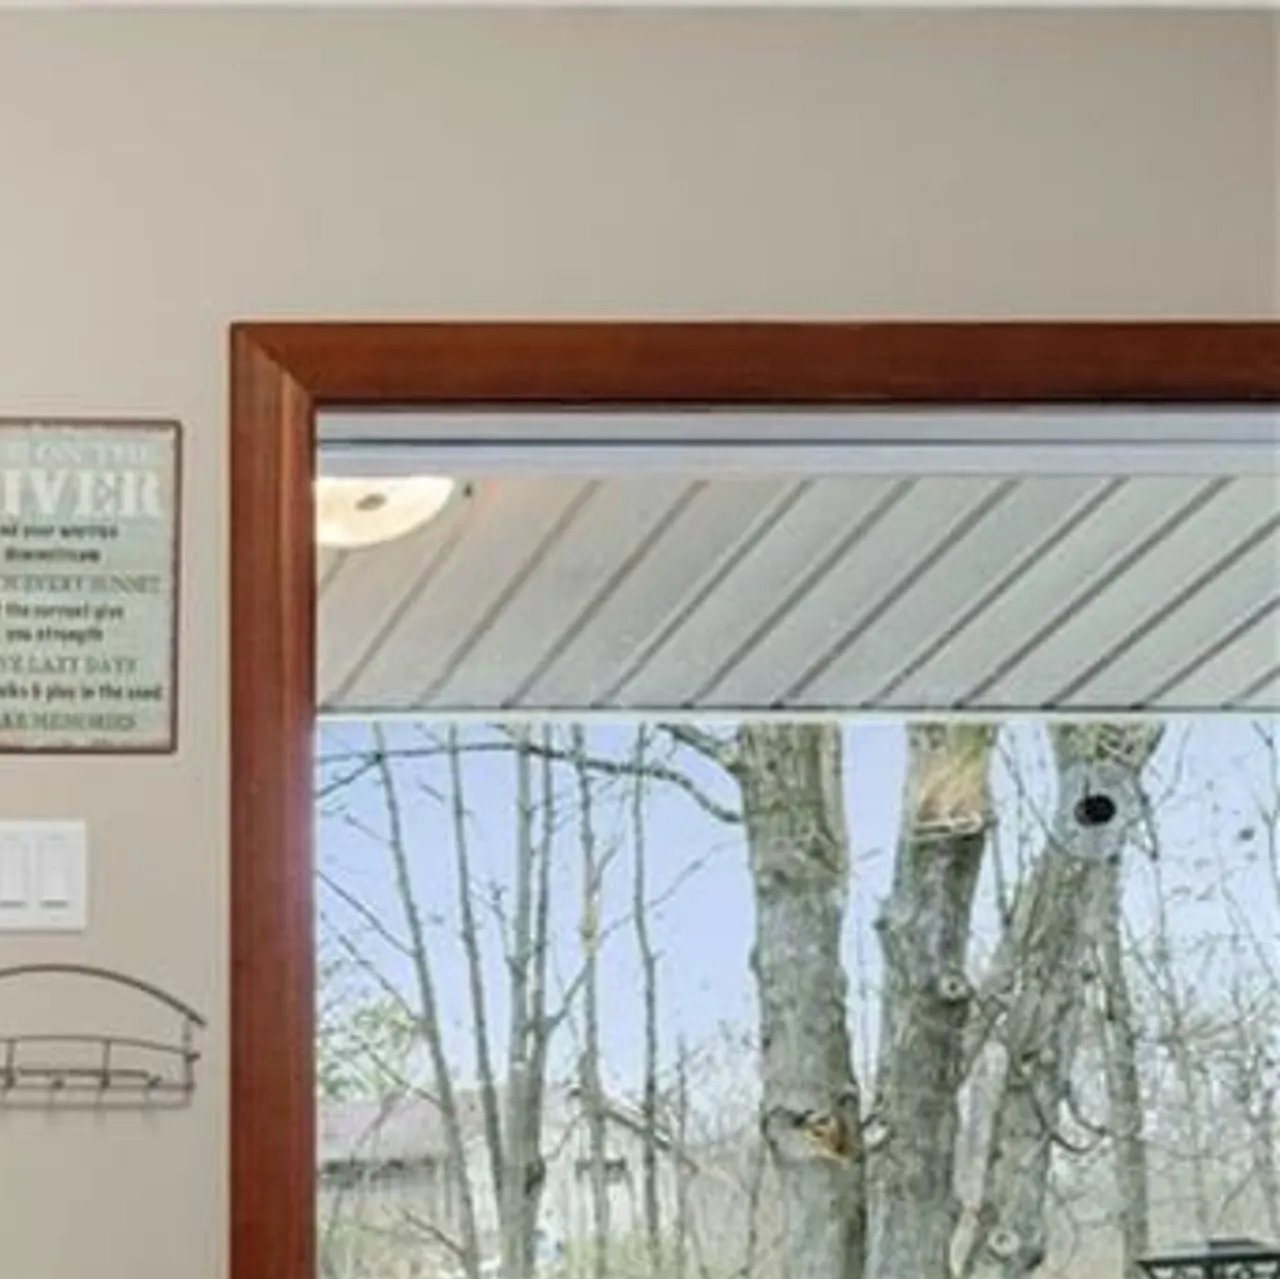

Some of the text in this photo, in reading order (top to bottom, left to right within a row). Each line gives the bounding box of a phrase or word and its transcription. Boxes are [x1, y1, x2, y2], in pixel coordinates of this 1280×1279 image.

[22, 525, 56, 541] your
[59, 524, 120, 540] worries
[25, 574, 85, 593] EVERY
[5, 602, 29, 617] the
[34, 601, 90, 617] current
[94, 603, 125, 621] give
[5, 626, 104, 646] you strength
[28, 655, 82, 674] LAZY
[85, 655, 139, 674] DAYS
[45, 681, 76, 702] play
[80, 684, 96, 698] in
[98, 681, 124, 699] the
[32, 712, 138, 731] MEMORIES
